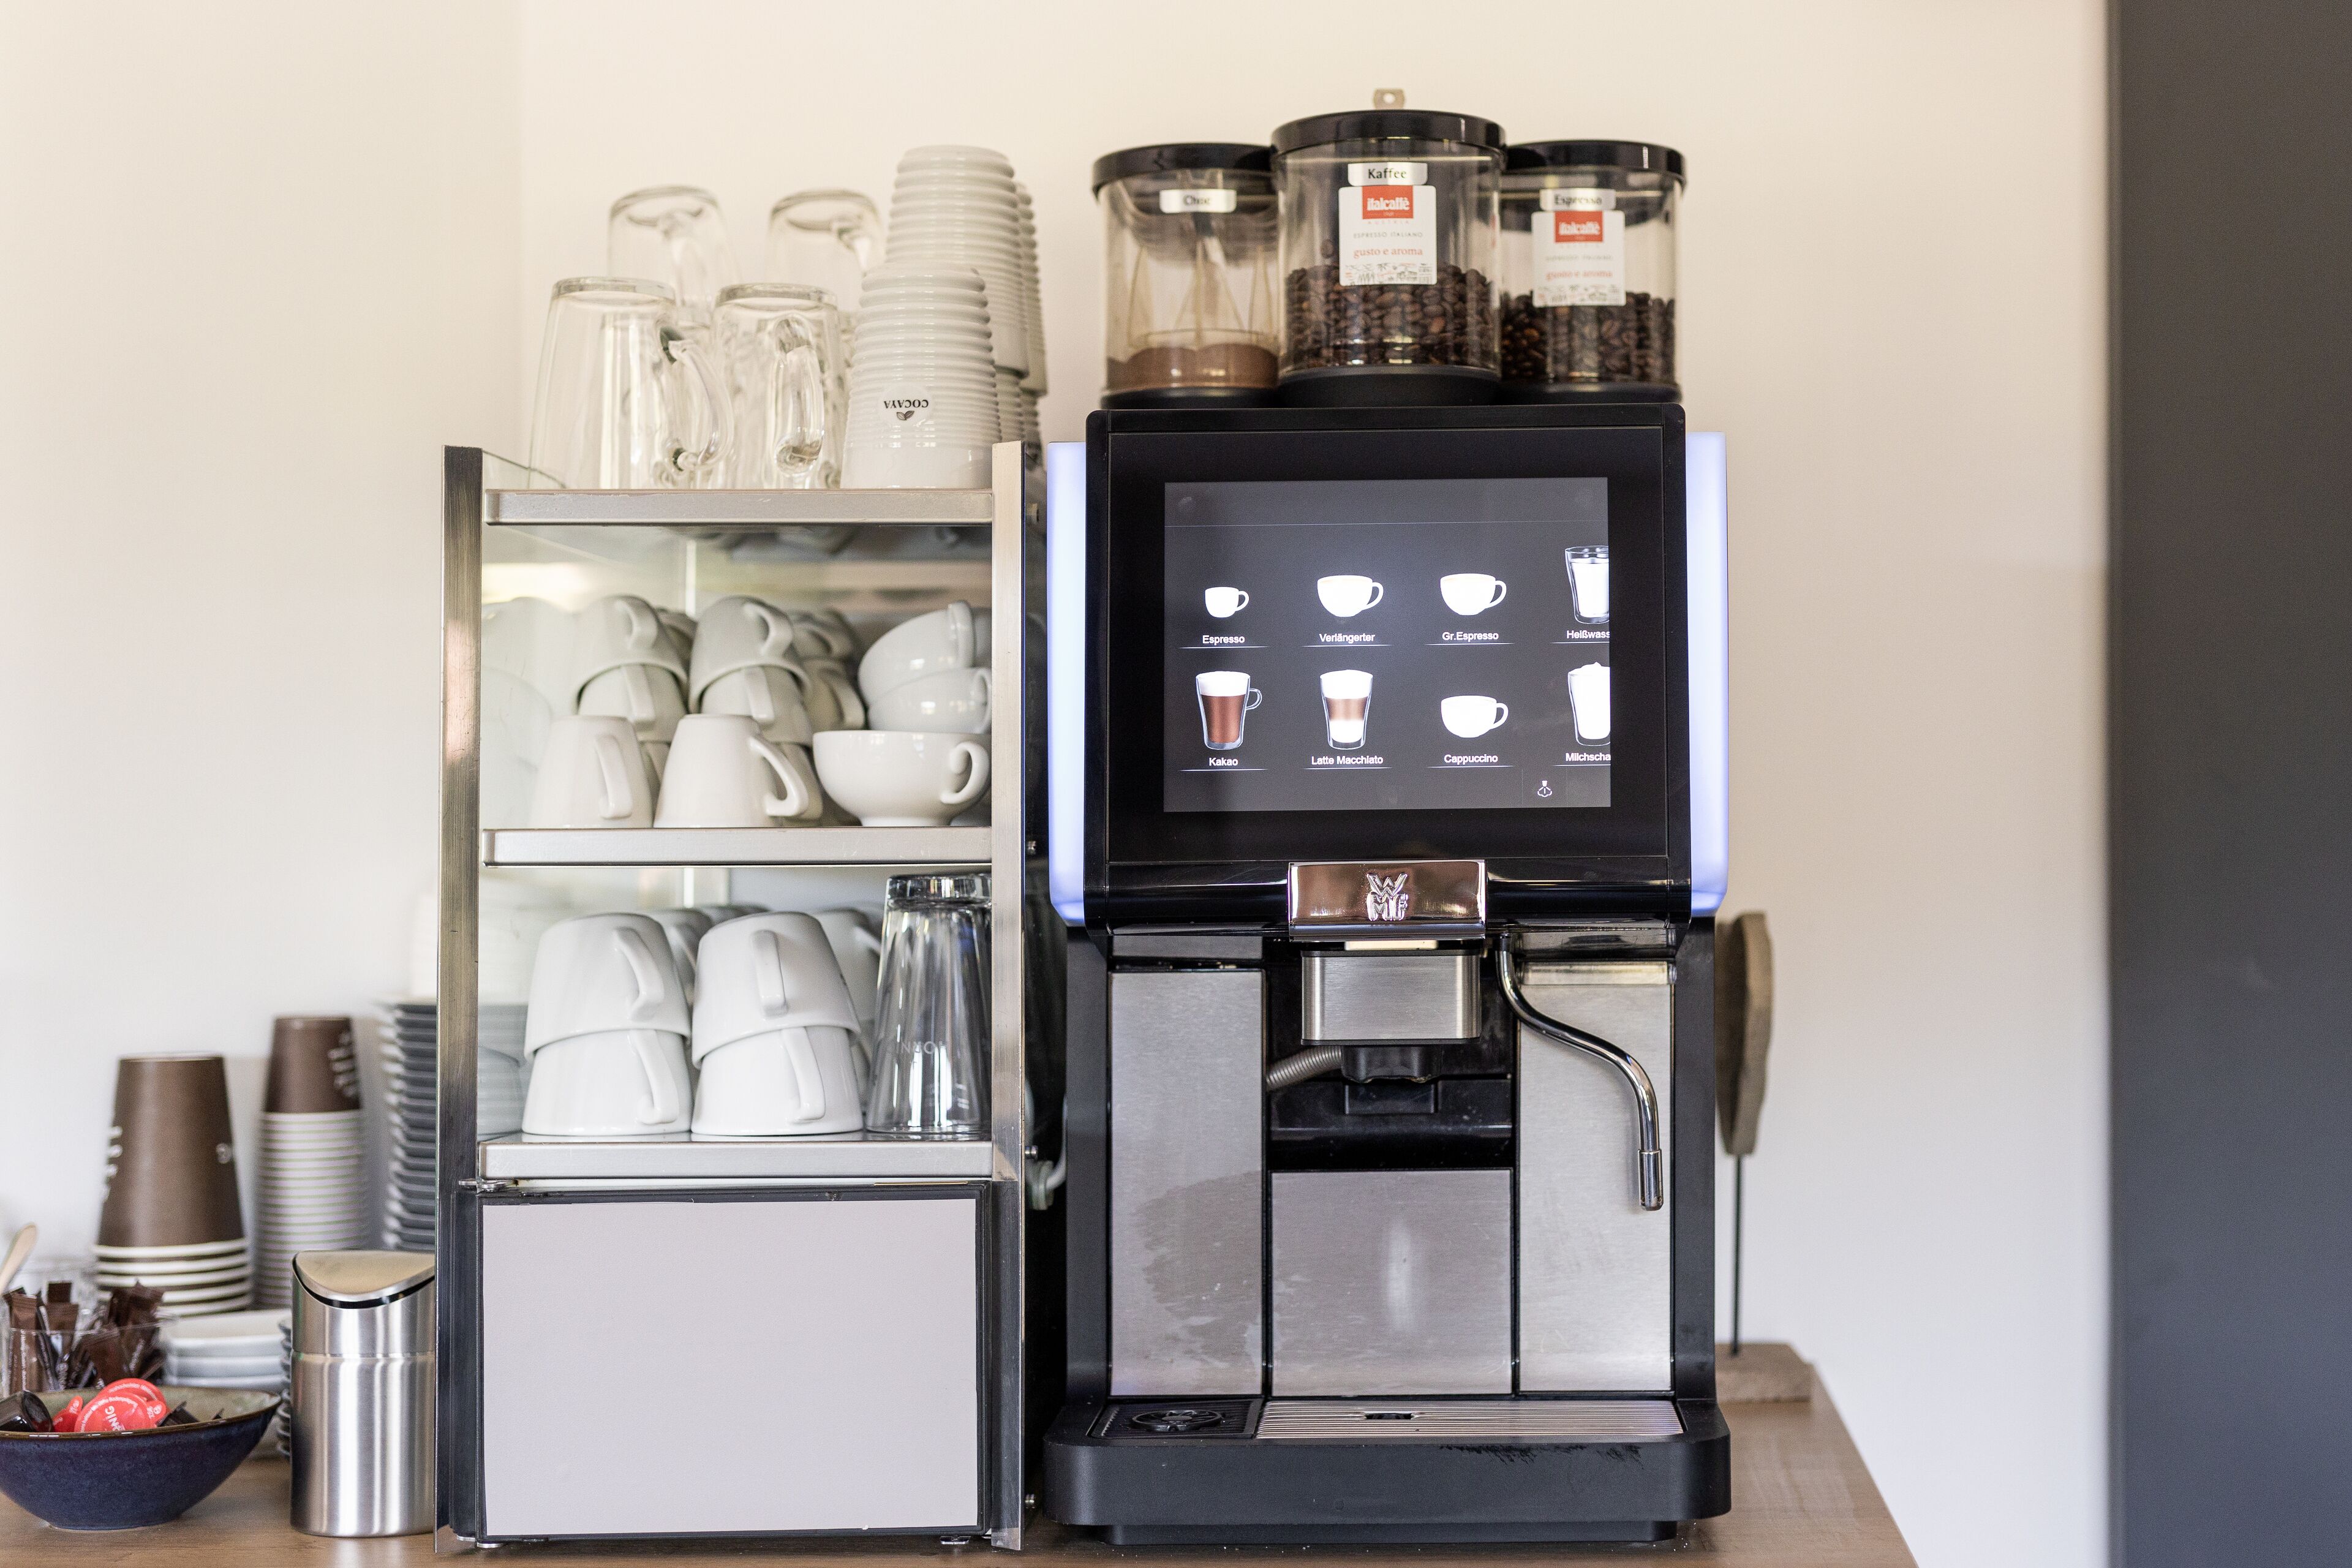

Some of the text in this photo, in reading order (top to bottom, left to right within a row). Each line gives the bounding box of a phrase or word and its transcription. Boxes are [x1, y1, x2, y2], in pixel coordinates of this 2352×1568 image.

[1368, 167, 1407, 179] Kaffee
[1554, 194, 1603, 207] Espresso
[1353, 248, 1381, 259] gusto
[883, 399, 929, 409] COCAYA
[1202, 635, 1245, 645] Espresso
[1319, 632, 1376, 644] Verlängerter
[1442, 631, 1499, 642] Gr.Espresso
[1208, 757, 1238, 766] Kakao
[1311, 755, 1384, 765] Latte Macchiato
[1444, 754, 1499, 765] Cappuccino
[1566, 752, 1611, 761] Milchscha
[1366, 873, 1408, 921] WMF
